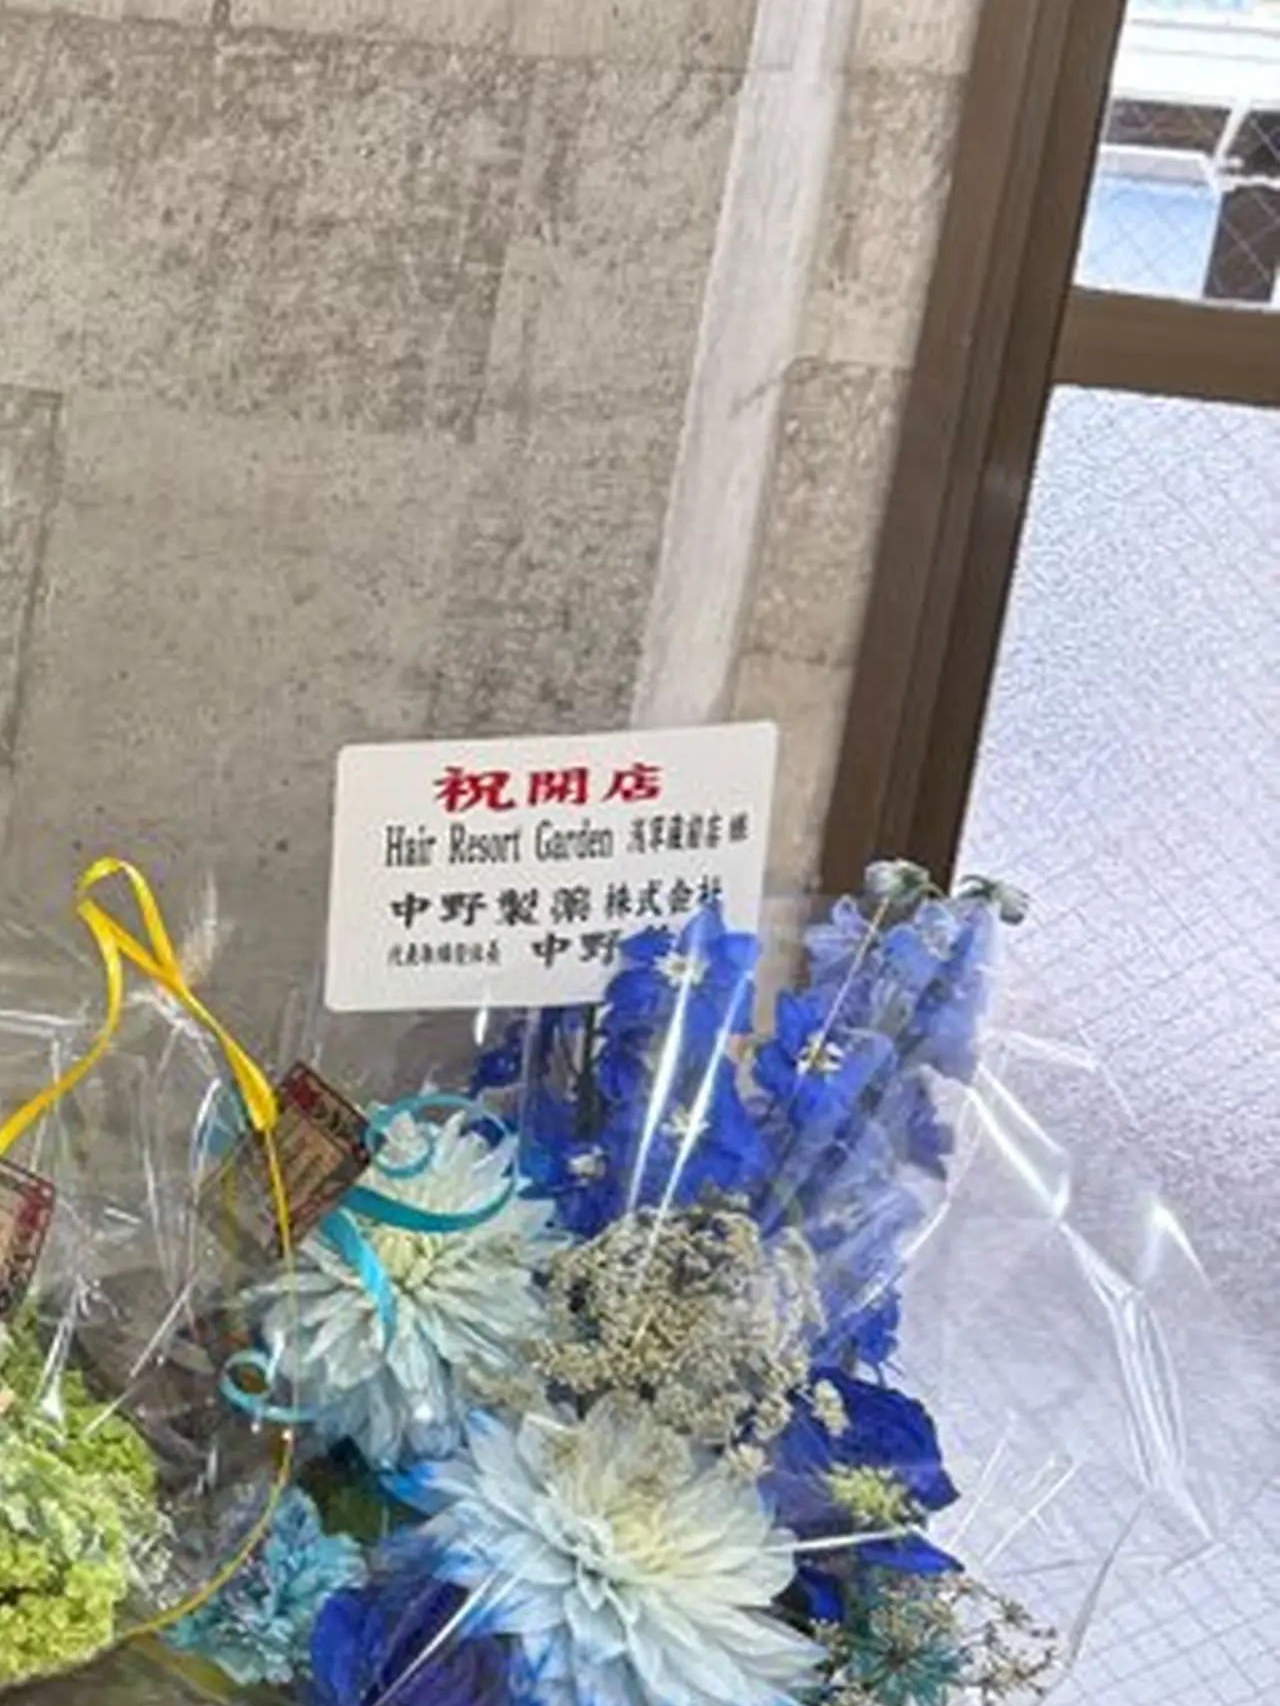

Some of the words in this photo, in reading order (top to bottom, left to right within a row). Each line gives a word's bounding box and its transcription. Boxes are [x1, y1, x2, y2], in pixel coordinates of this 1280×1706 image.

[433, 763, 664, 813] 祝開店
[385, 824, 436, 868] Hair
[448, 823, 523, 865] Resort
[534, 818, 615, 863] Garden
